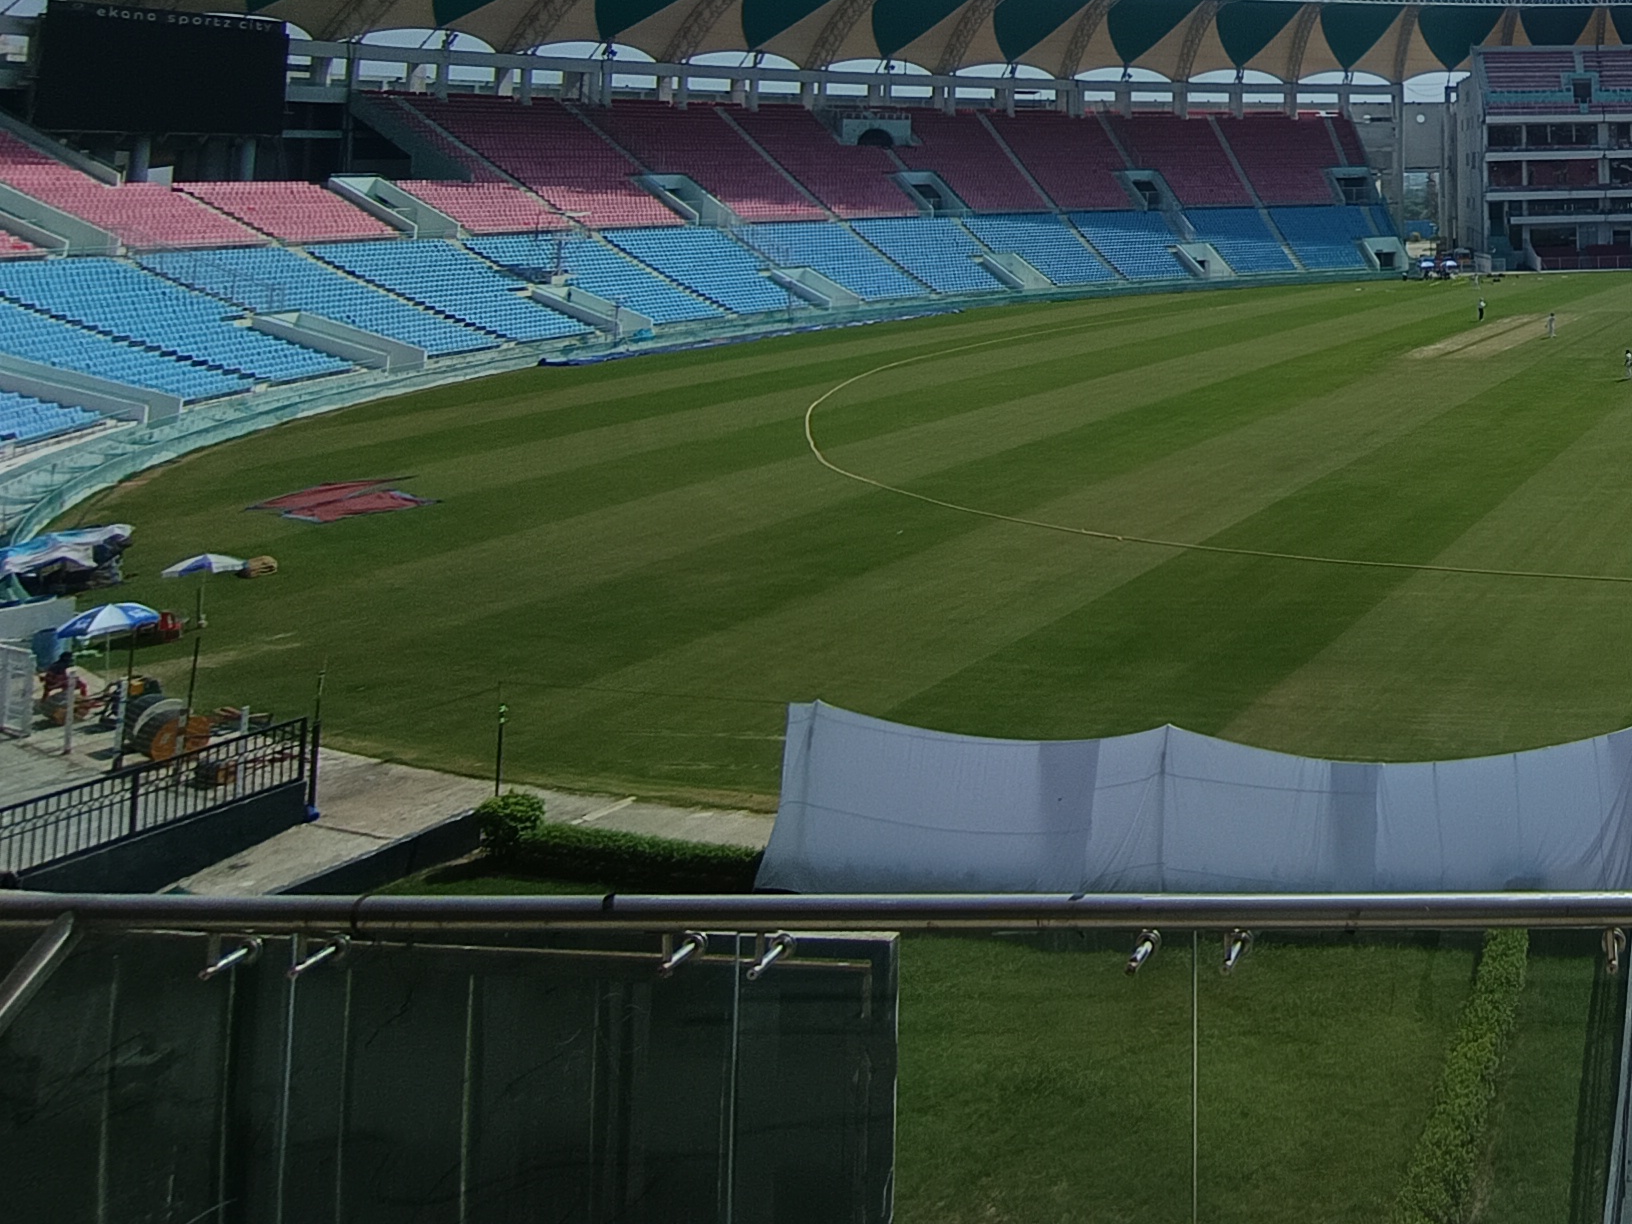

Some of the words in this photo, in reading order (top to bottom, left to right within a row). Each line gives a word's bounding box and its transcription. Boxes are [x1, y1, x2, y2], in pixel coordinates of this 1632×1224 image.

[96, 7, 156, 21] ekana
[167, 14, 232, 28] sportz
[239, 19, 272, 32] city
